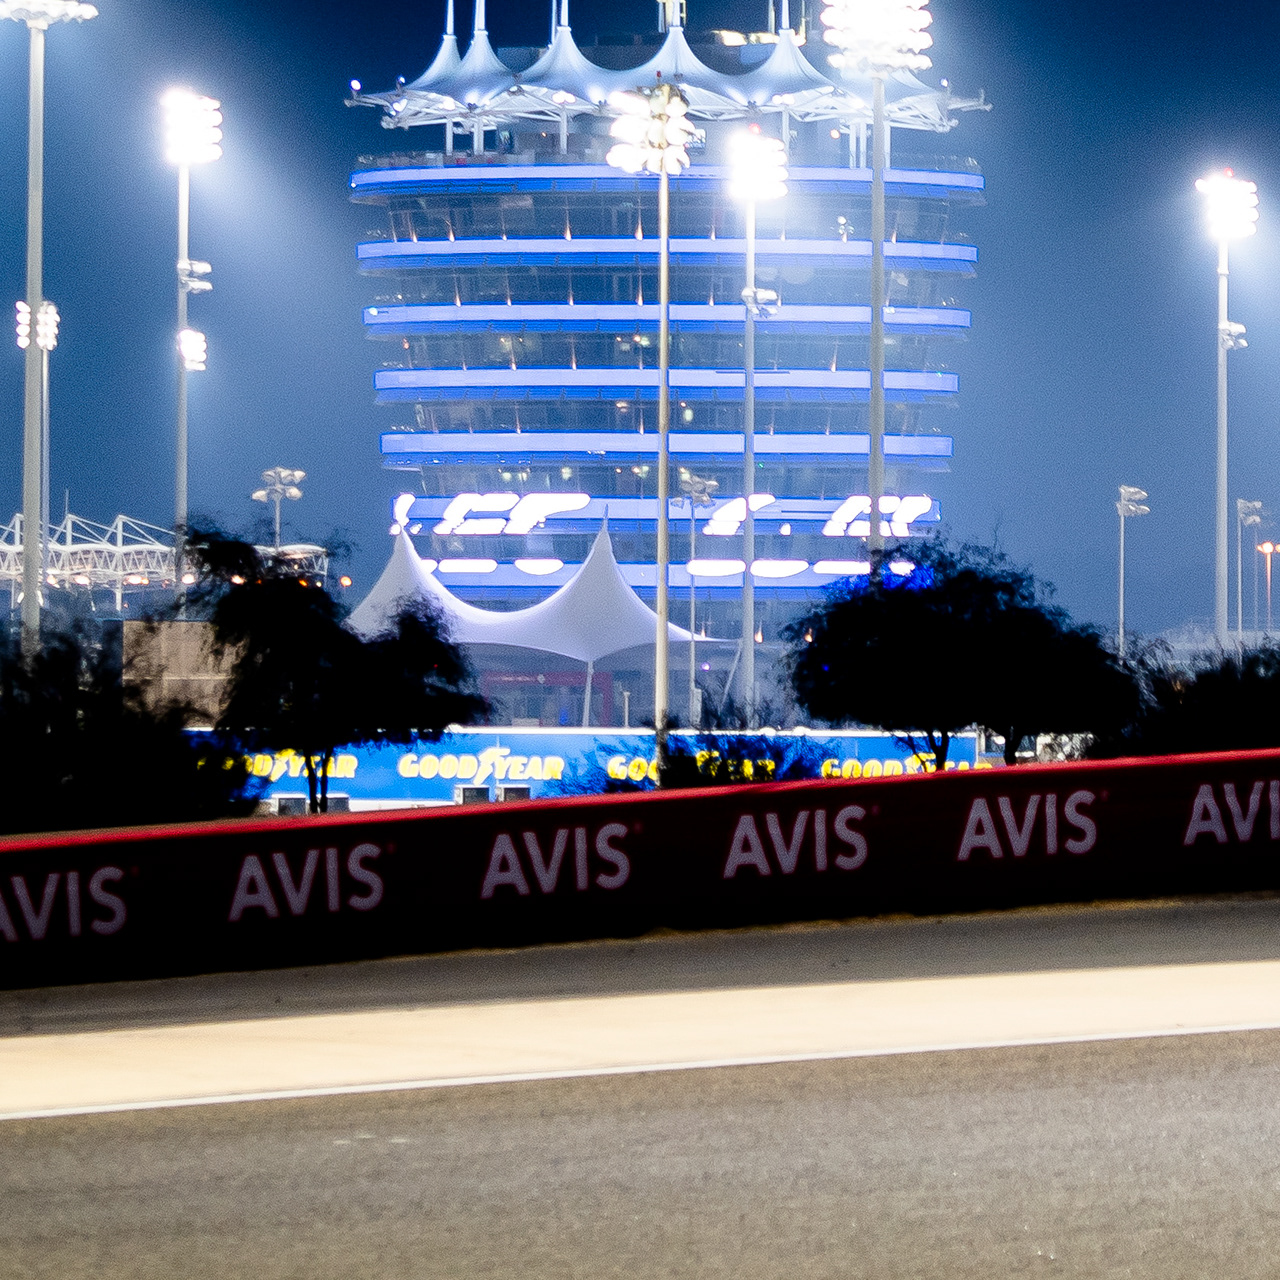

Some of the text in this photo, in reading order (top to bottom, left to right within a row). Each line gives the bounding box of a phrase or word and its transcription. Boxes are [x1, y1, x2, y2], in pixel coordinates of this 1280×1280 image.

[397, 747, 565, 786] GOODYEAR
[482, 822, 630, 898] AVIS
[724, 804, 867, 878] AVIS
[958, 790, 1097, 860] AVIS
[230, 842, 383, 920] AVIS
